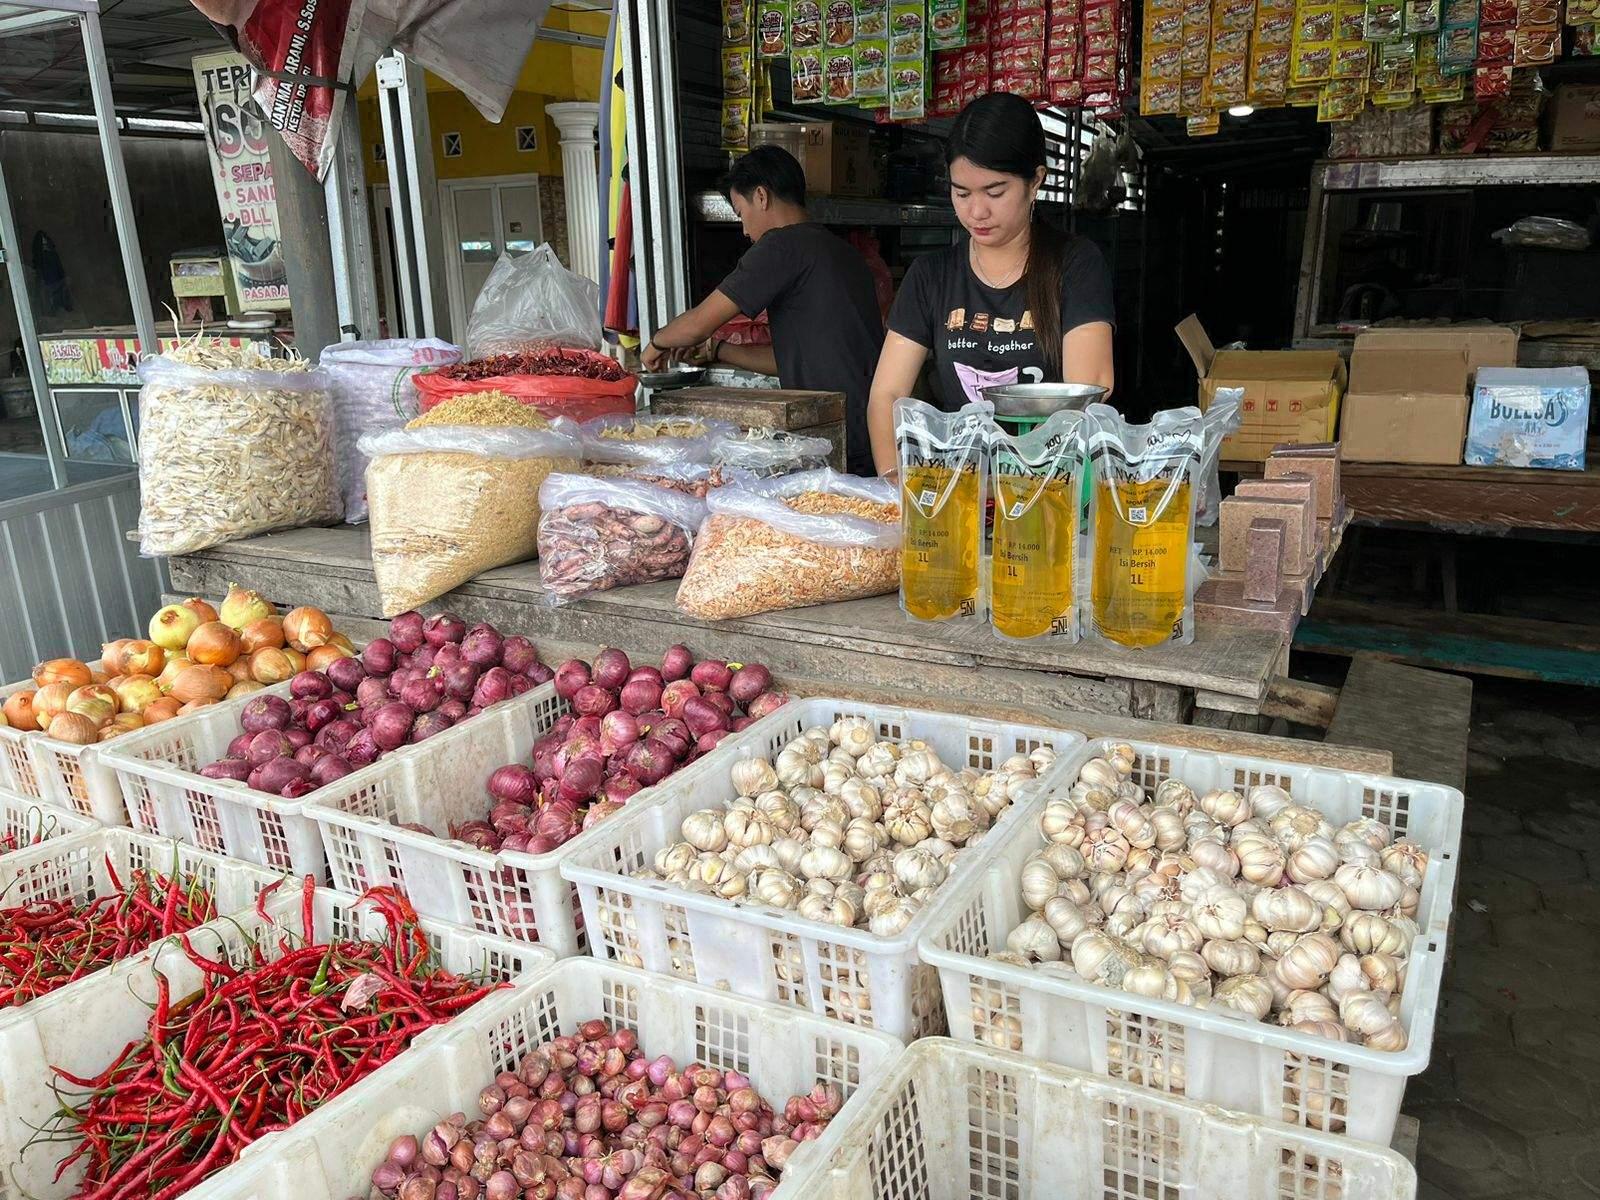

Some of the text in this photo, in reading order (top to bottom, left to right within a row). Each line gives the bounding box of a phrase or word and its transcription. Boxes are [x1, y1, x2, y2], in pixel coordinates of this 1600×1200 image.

[287, 99, 304, 132] KETUA
[240, 207, 271, 225] DLL
[244, 286, 279, 300] PASAR
[948, 338, 1034, 354] better together
[918, 539, 939, 548] Bersih
[918, 552, 929, 562] 1L
[1007, 551, 1028, 561] Bersih
[1145, 547, 1168, 556] 14.000
[1120, 558, 1156, 568] Isi Bersih
[1007, 565, 1018, 577] 1L
[1130, 574, 1144, 585] 1L
